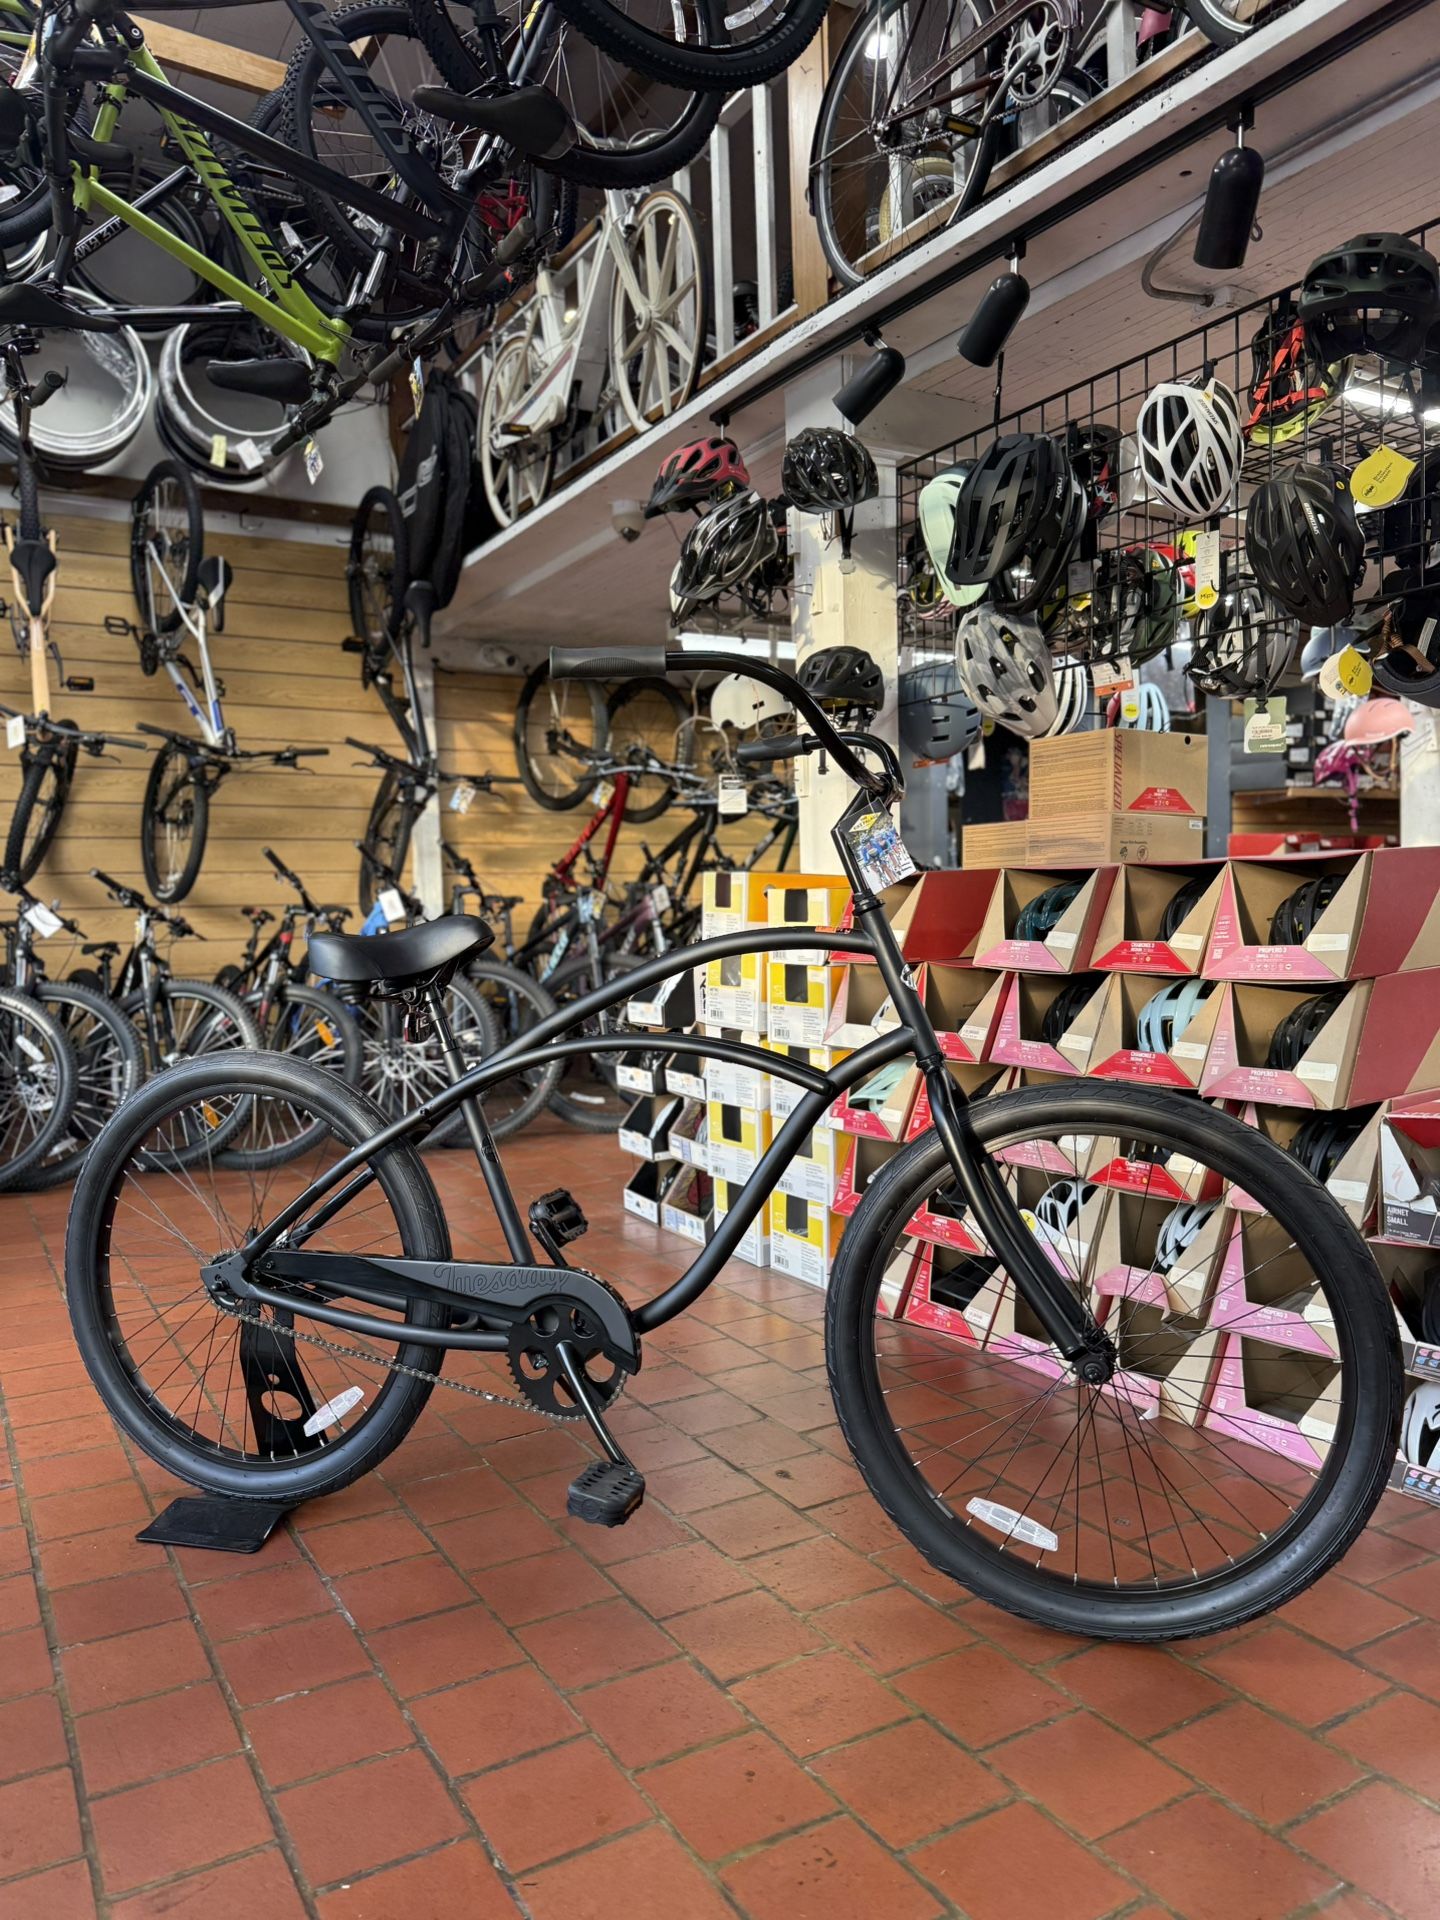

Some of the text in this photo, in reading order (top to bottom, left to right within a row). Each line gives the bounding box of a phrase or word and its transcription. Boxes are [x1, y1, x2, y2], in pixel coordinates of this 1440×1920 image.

[169, 112, 293, 289] SPECIALIZE
[1114, 733, 1123, 811] SPECIALIZED
[1251, 1069, 1274, 1077] PROPERO
[1387, 1206, 1409, 1217] AIRNET
[1387, 1215, 1409, 1226] SMALL
[433, 1264, 570, 1295] Tuesday
